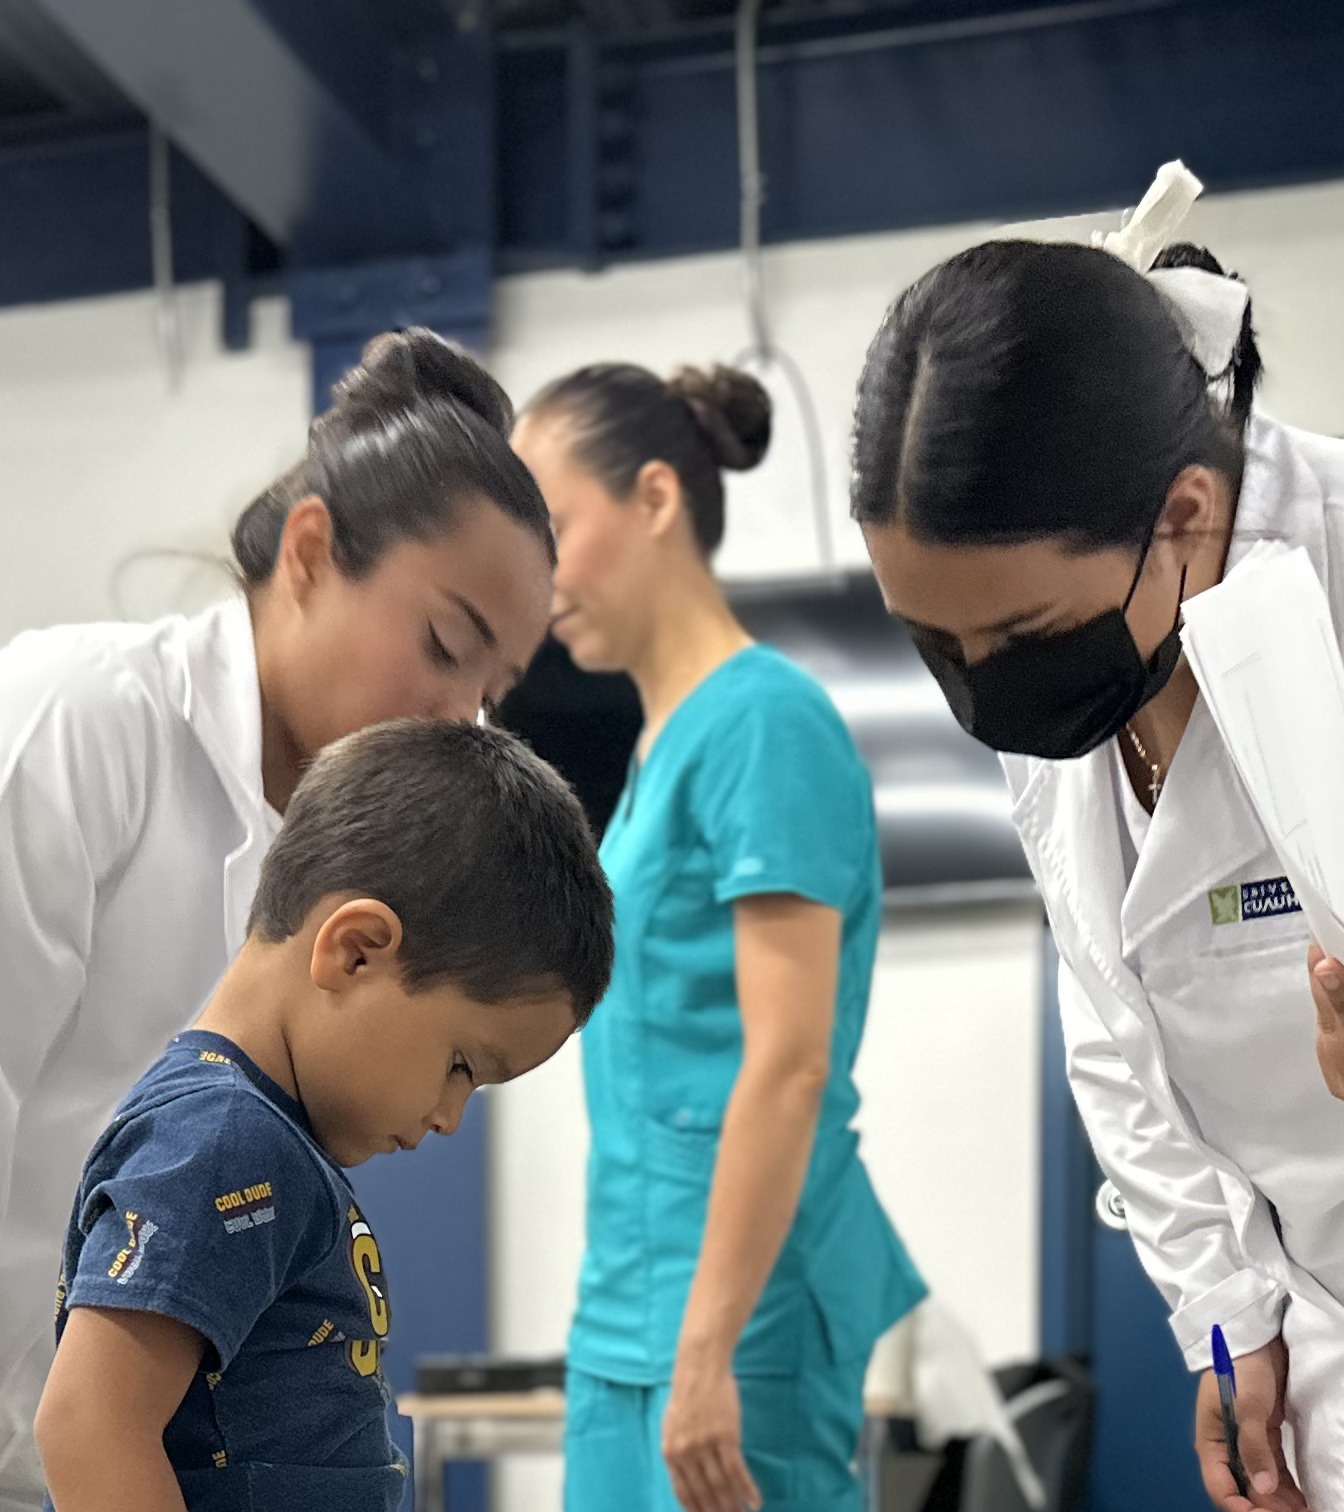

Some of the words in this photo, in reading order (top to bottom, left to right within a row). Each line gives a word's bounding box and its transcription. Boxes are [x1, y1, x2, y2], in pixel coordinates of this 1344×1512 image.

[215, 1191, 246, 1212] COOL
[244, 1181, 273, 1202] DUDE
[107, 1248, 133, 1278] COOL
